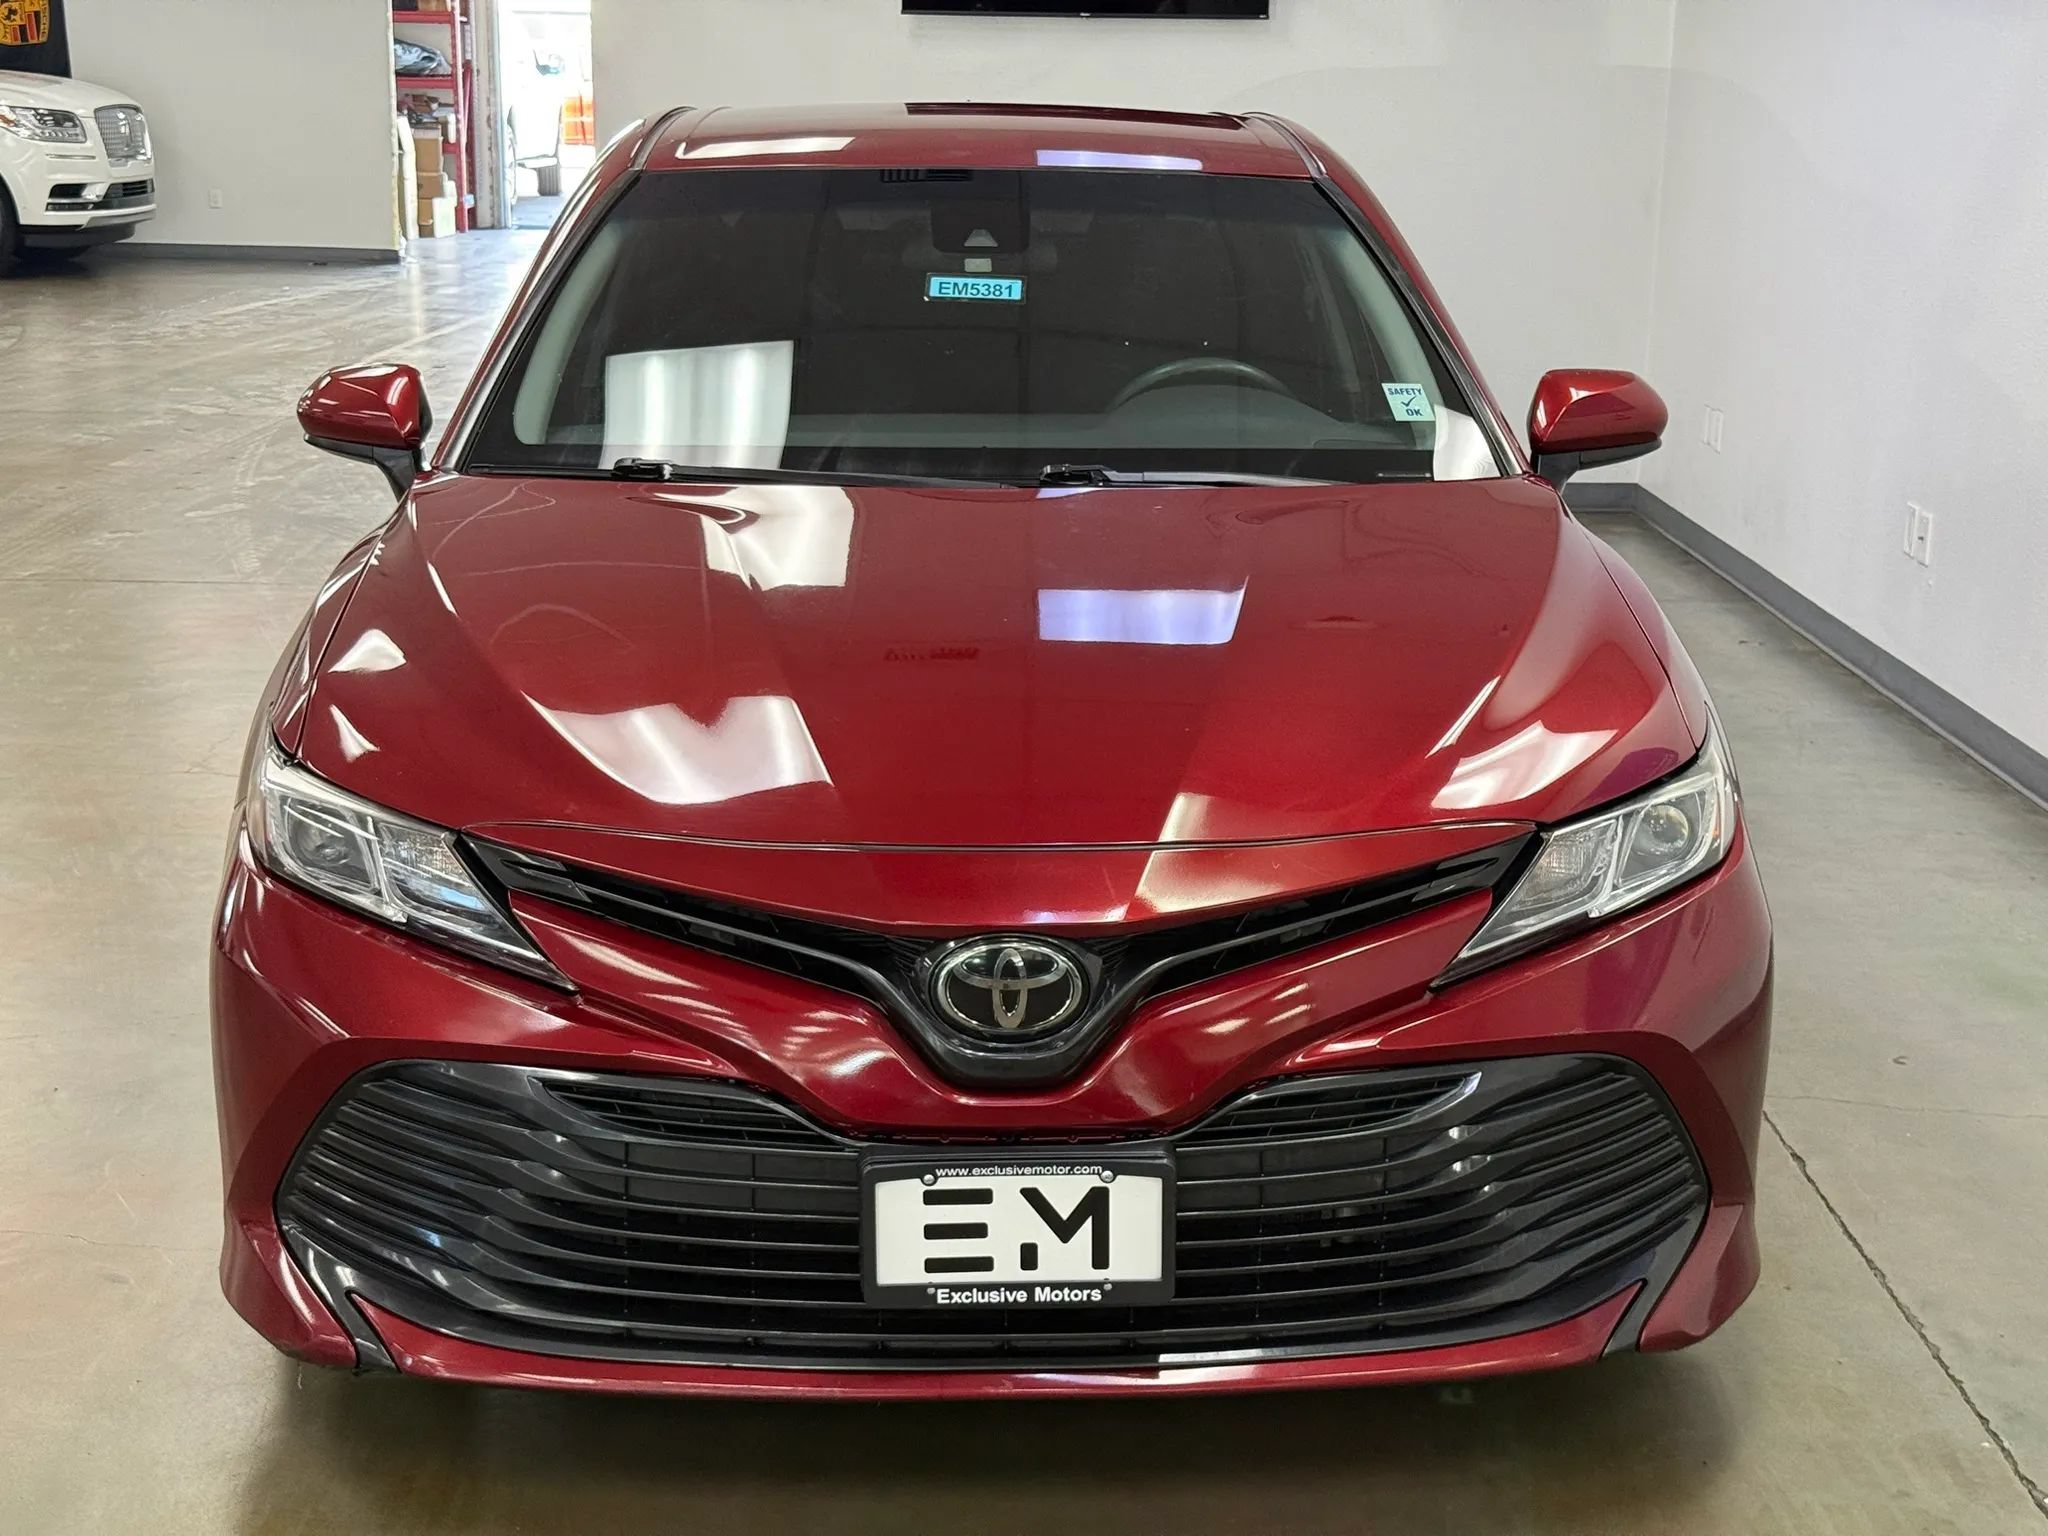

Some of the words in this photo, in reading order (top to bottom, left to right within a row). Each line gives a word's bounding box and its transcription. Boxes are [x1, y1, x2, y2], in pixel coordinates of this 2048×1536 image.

[938, 281, 1014, 298] EM5381
[1387, 387, 1423, 396] SAFETY
[1405, 408, 1424, 417] OK
[935, 1163, 1102, 1177] www.exclusivemotor.com
[936, 1287, 1028, 1304] Exclusive
[1034, 1286, 1102, 1303] Motors
